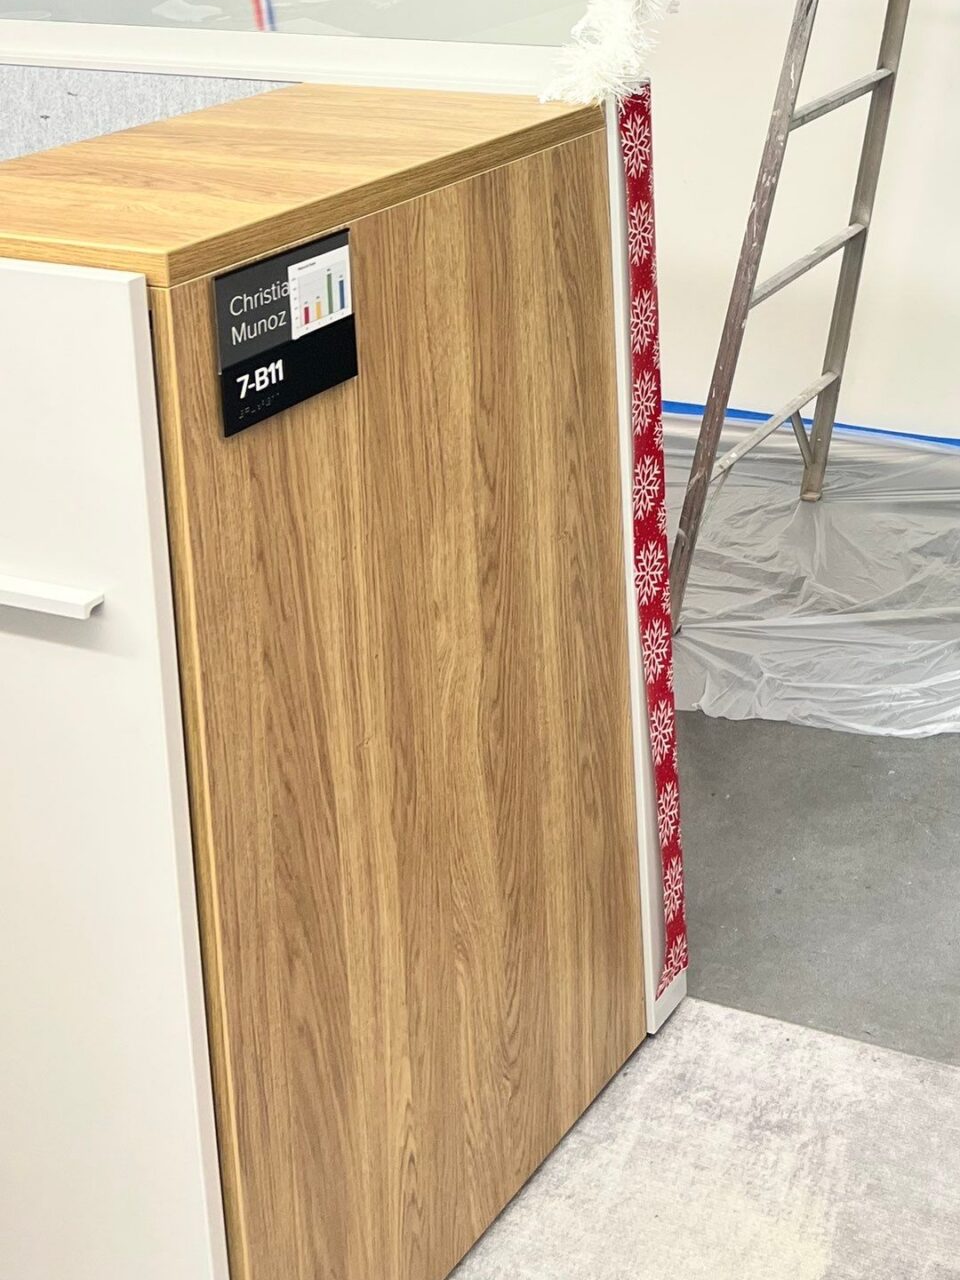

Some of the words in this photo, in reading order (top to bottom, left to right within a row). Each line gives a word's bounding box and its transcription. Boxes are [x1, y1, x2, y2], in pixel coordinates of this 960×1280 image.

[229, 281, 290, 316] Christia
[231, 311, 287, 346] Munoz
[236, 359, 284, 400] 7-B11
